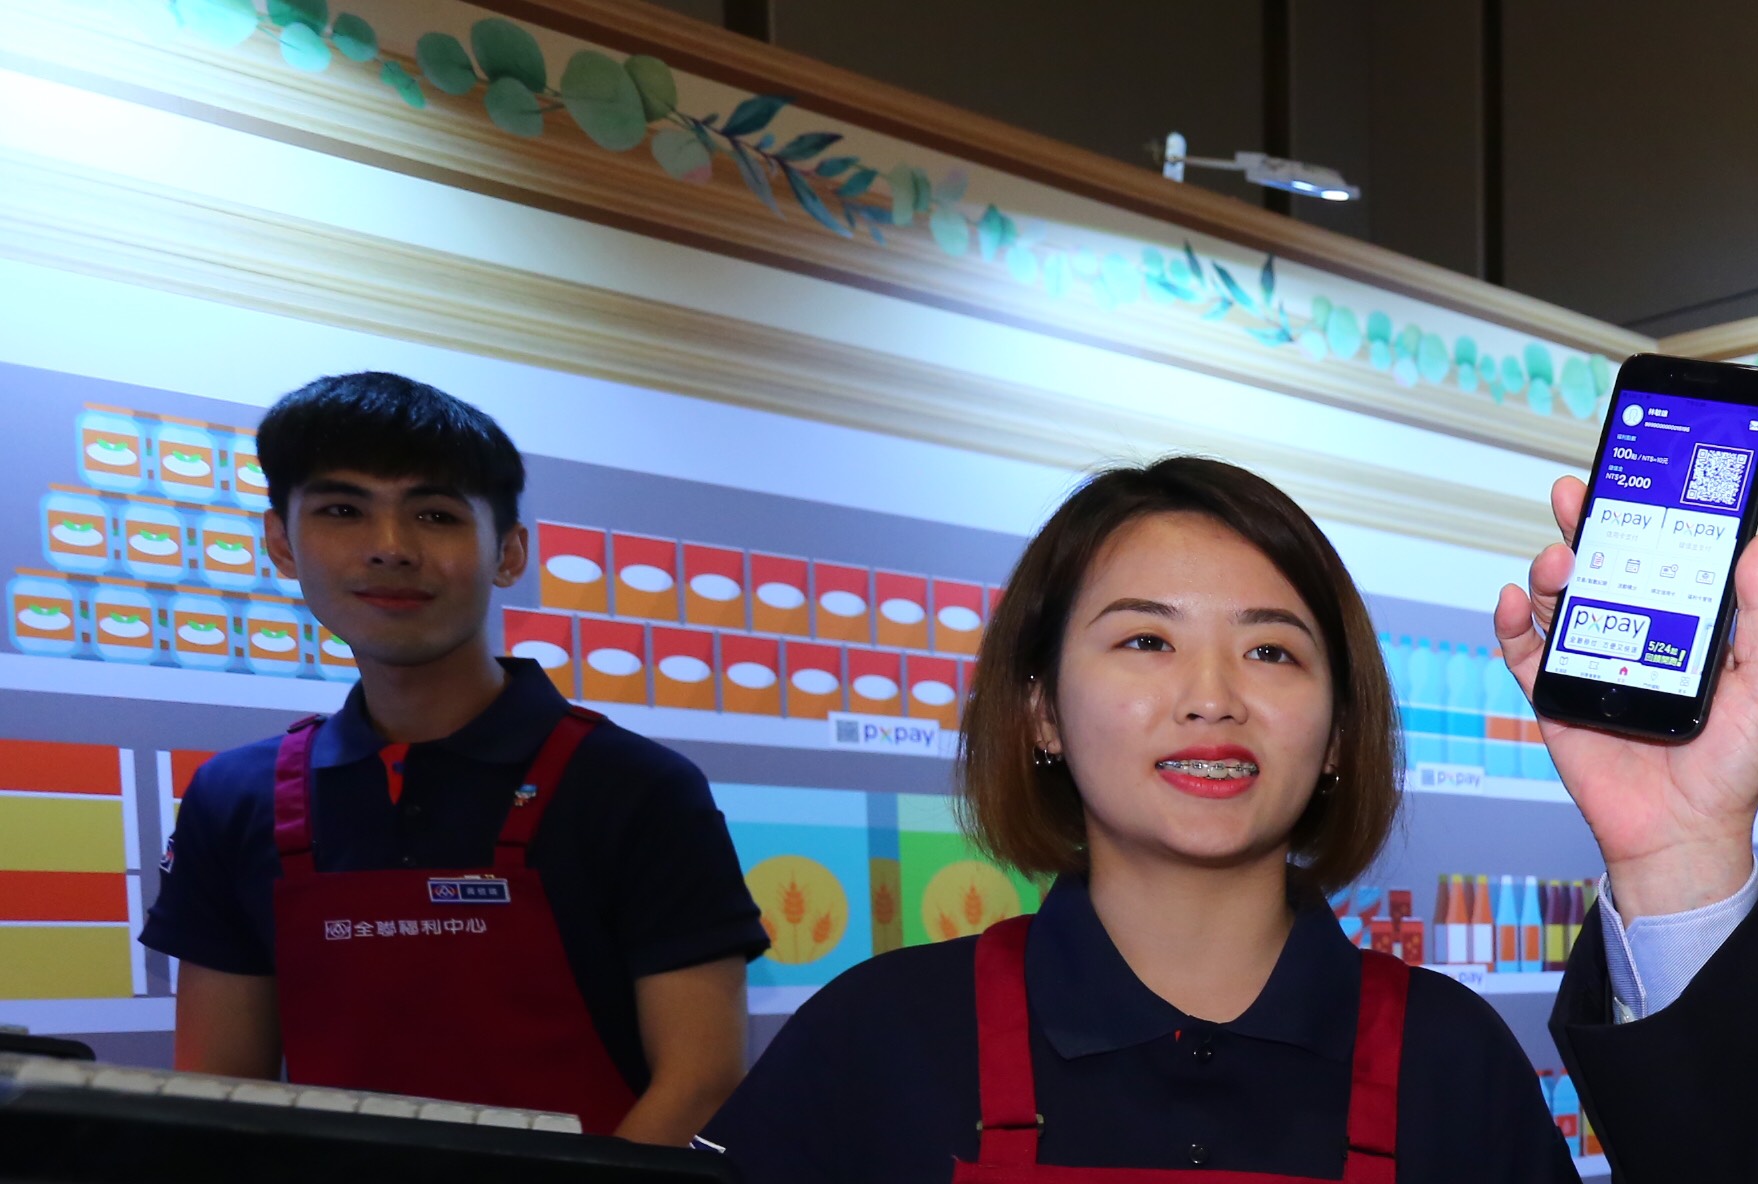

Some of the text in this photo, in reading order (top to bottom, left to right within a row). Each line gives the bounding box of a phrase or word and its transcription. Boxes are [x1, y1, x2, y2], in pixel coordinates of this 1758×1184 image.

[1605, 473, 1651, 489] NT$2,000
[1600, 509, 1652, 529] pxpay
[1673, 519, 1725, 540] pxpay
[1574, 609, 1646, 638] pxpay
[864, 724, 934, 747] pxpay
[1438, 771, 1480, 788] pxpay
[354, 918, 487, 937] 全聯福利中心
